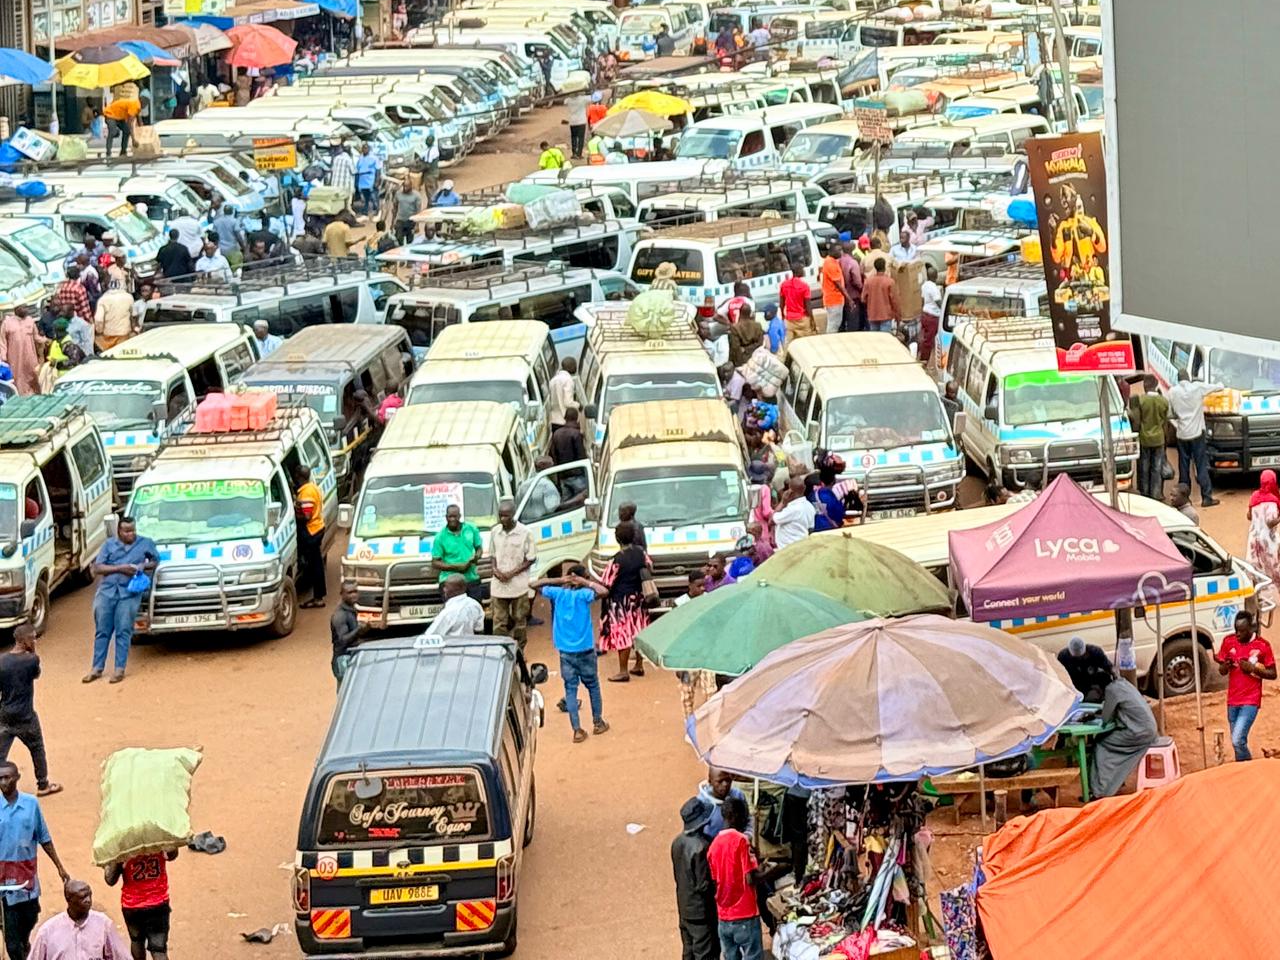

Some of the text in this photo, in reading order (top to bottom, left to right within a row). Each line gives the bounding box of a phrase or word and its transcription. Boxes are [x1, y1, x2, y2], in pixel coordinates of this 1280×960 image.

[1034, 537, 1099, 559] Lyca
[1066, 553, 1101, 562] Mobile
[983, 591, 1065, 609] Connect your world
[419, 638, 441, 646] TAXI
[349, 801, 445, 828] Safe Journey
[132, 857, 161, 881] 23
[319, 861, 334, 874] 03
[382, 888, 404, 902] UAV
